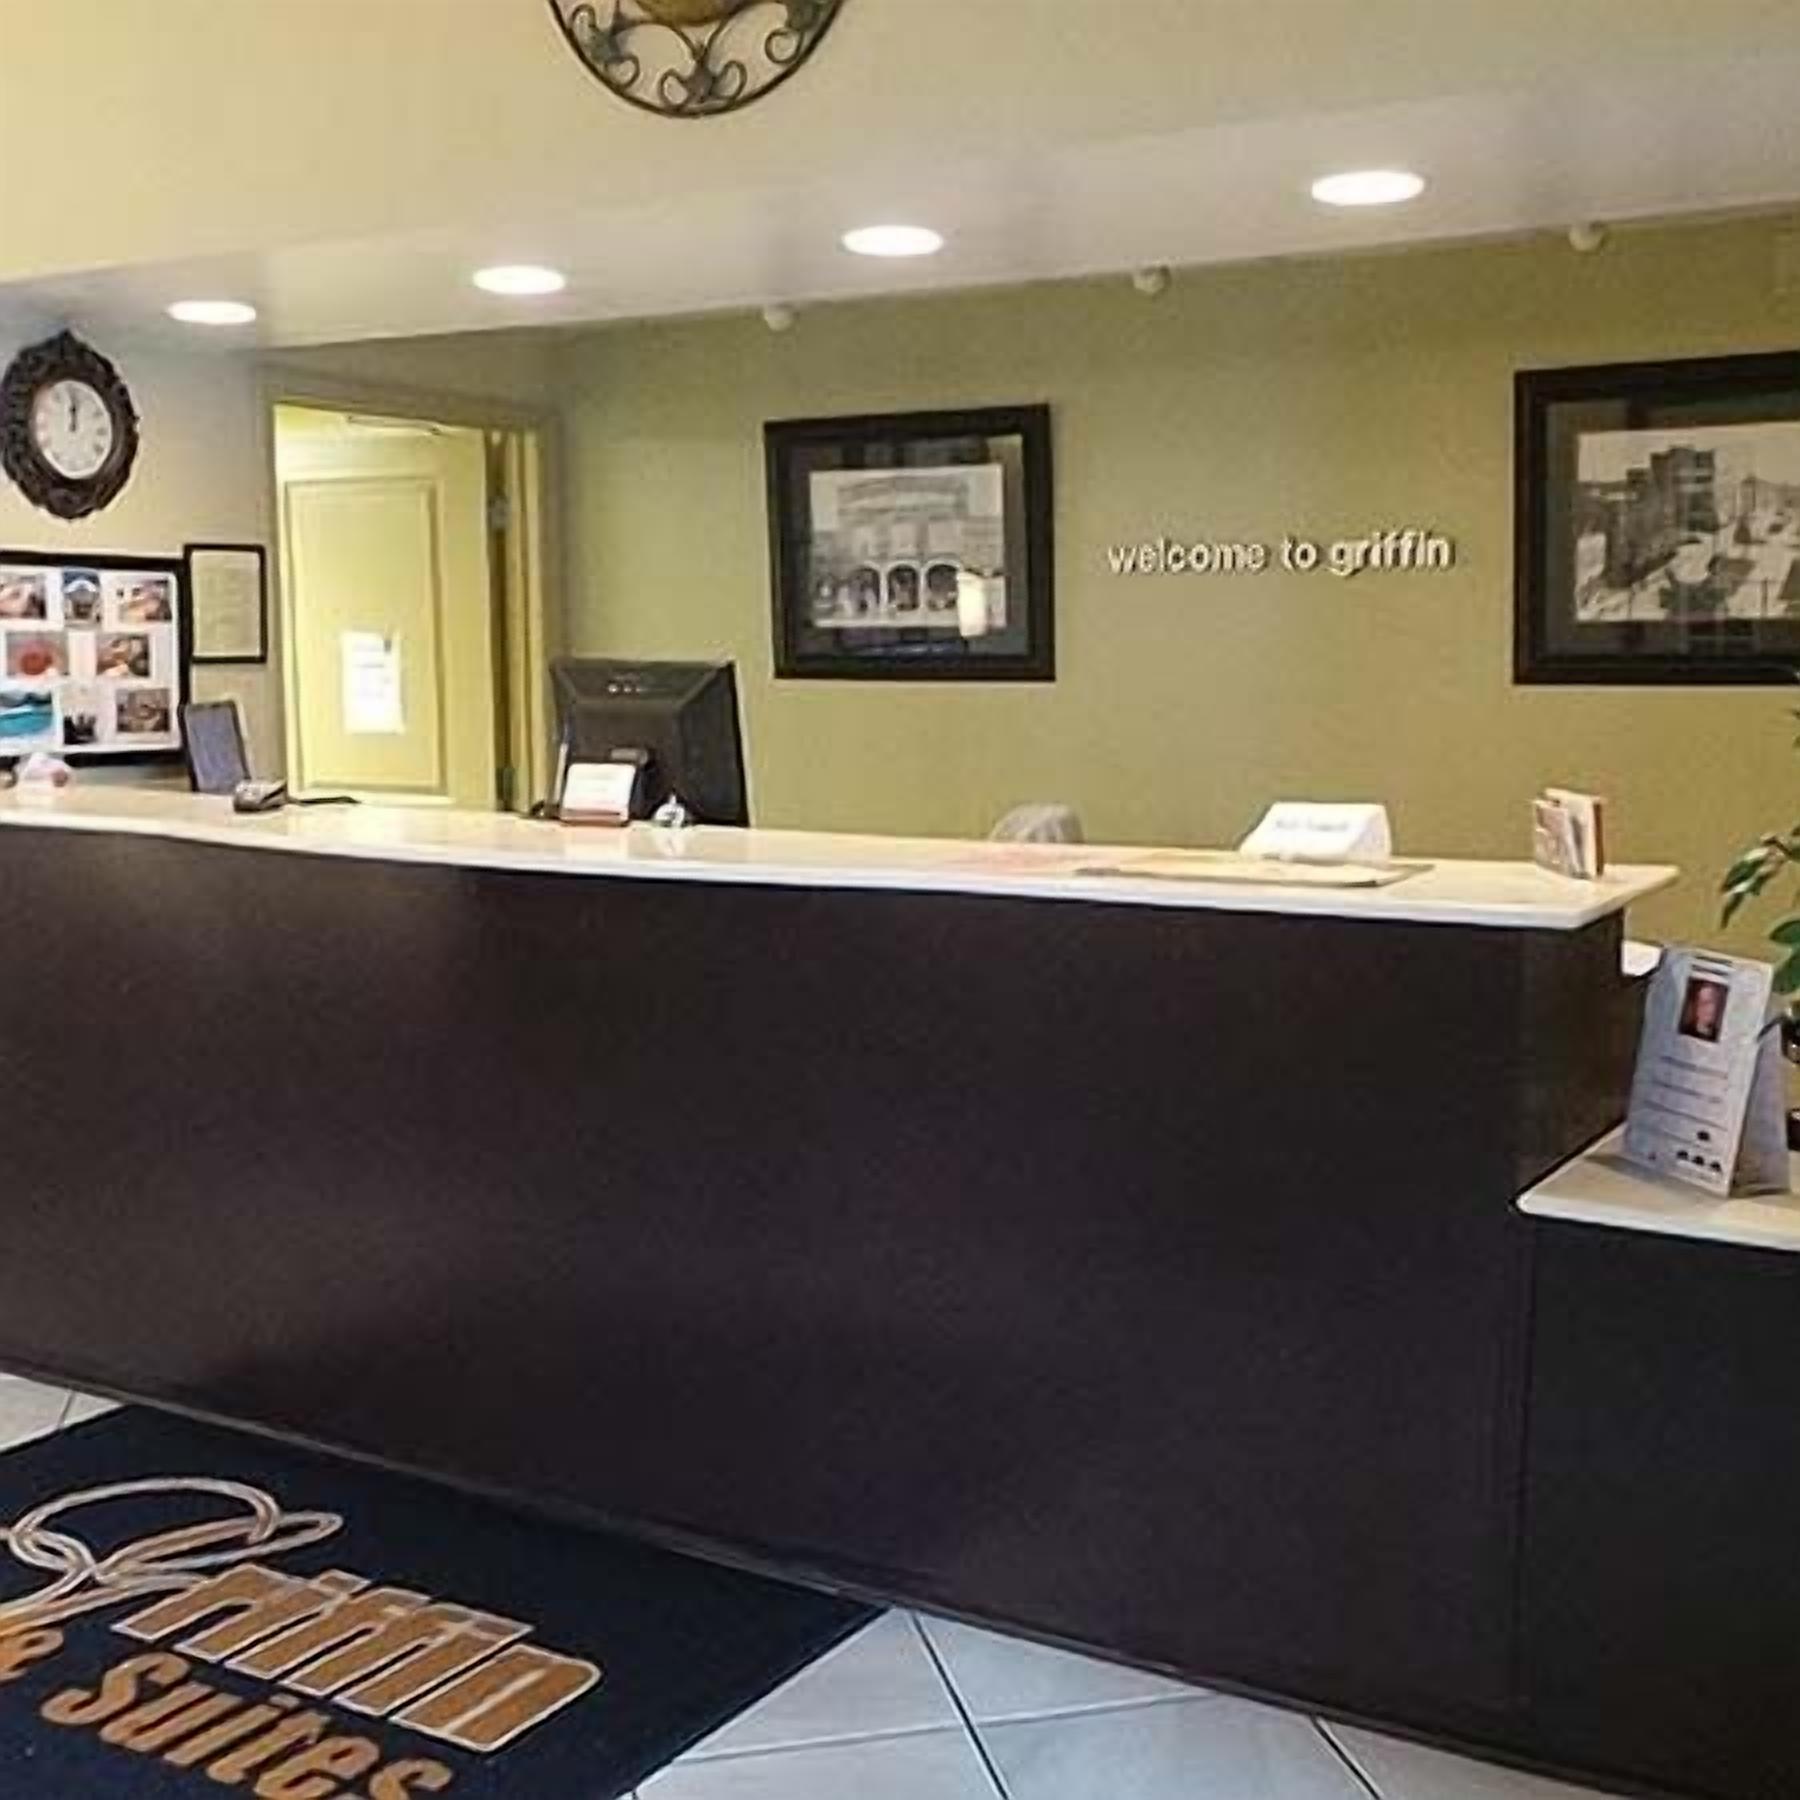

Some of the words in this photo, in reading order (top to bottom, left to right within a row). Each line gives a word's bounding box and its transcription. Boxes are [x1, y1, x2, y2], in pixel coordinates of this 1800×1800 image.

[1106, 537, 1265, 573] welcome
[1282, 536, 1318, 570] to
[1330, 531, 1455, 577] griffin
[40, 1651, 453, 1800] Suites
